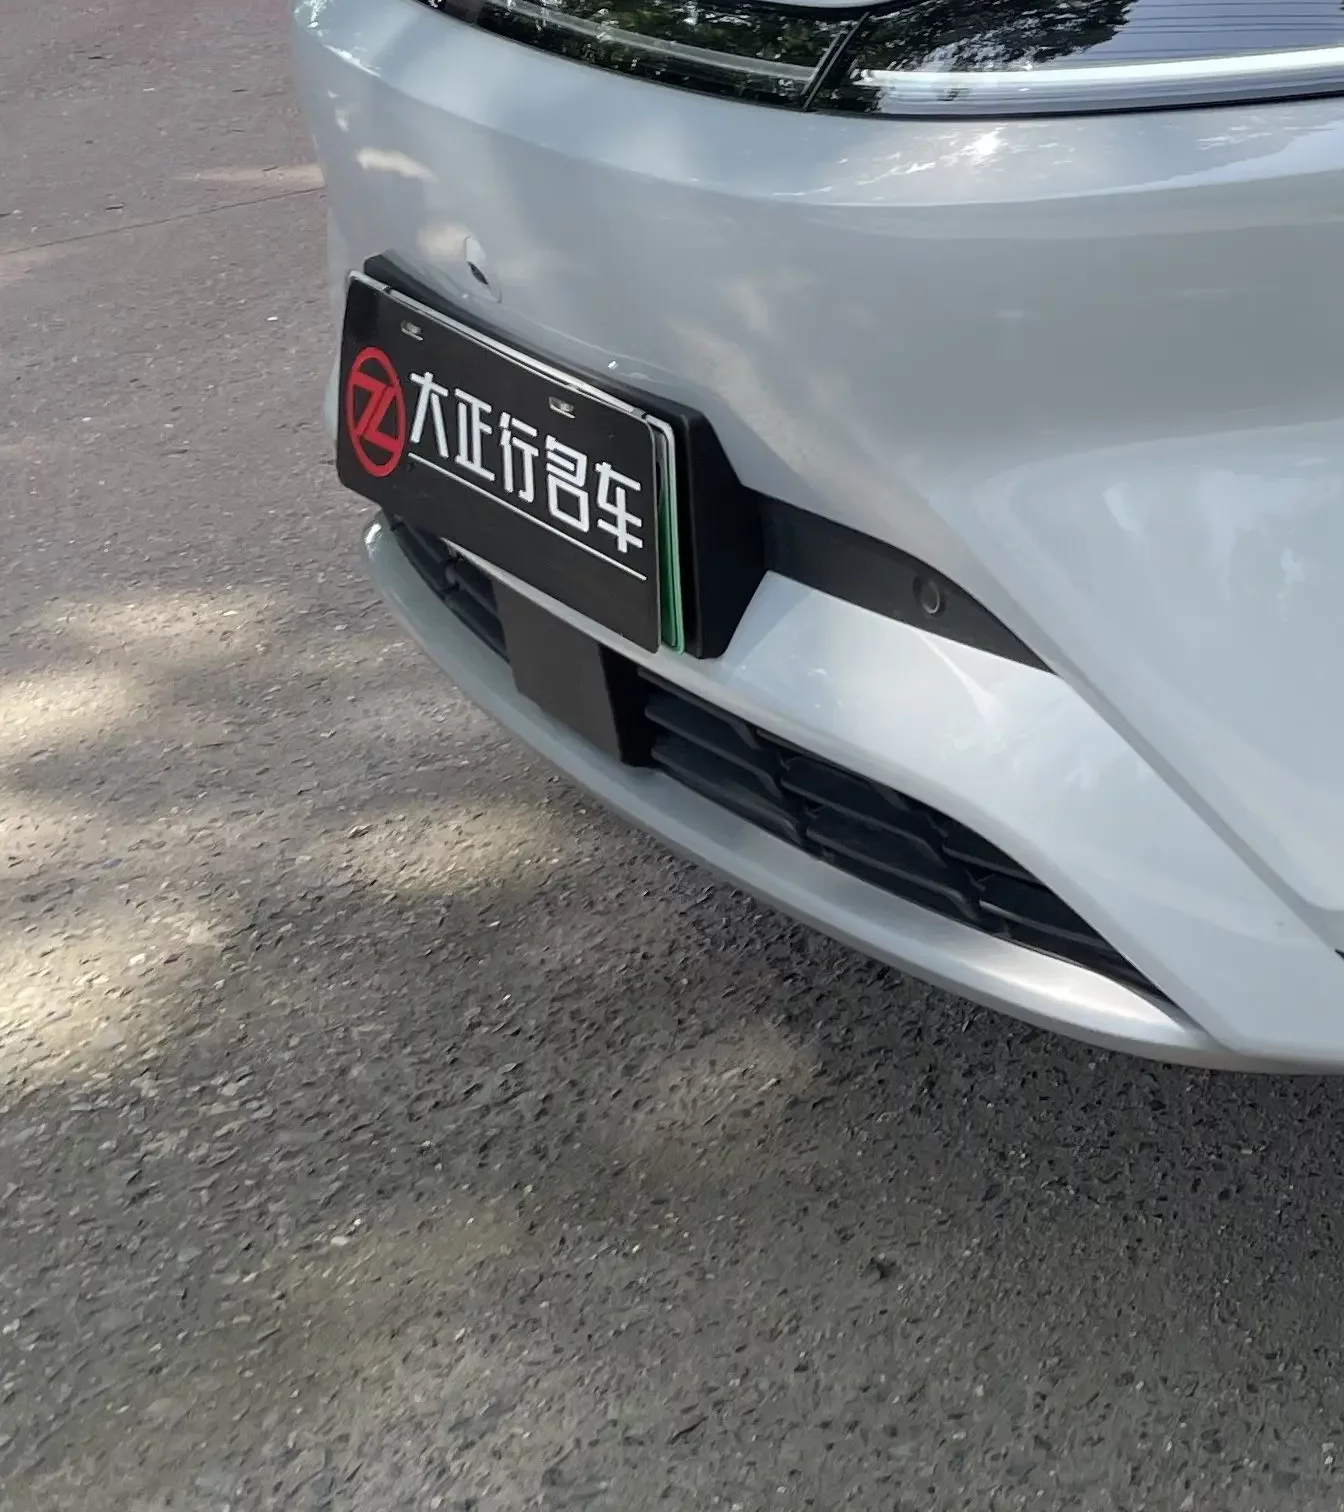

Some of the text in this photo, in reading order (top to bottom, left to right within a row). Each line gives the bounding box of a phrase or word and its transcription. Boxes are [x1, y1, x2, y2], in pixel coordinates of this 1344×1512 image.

[408, 370, 646, 554] 大正行名车
